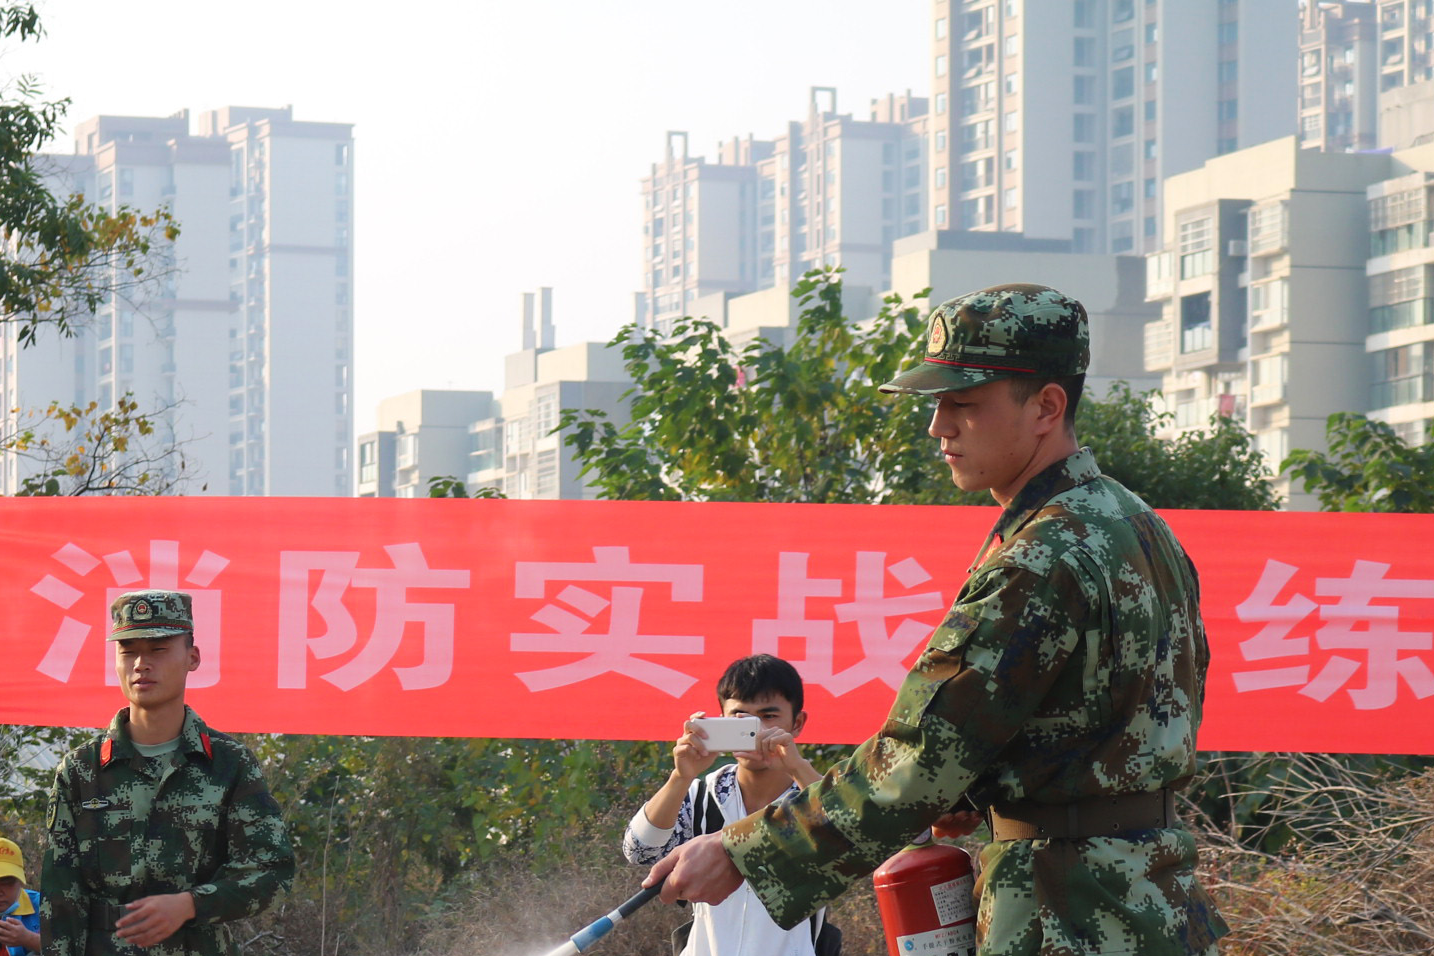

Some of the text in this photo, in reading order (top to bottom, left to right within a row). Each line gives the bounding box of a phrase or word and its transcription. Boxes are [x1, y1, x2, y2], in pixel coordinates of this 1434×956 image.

[30, 540, 1434, 710] 消防实战练
